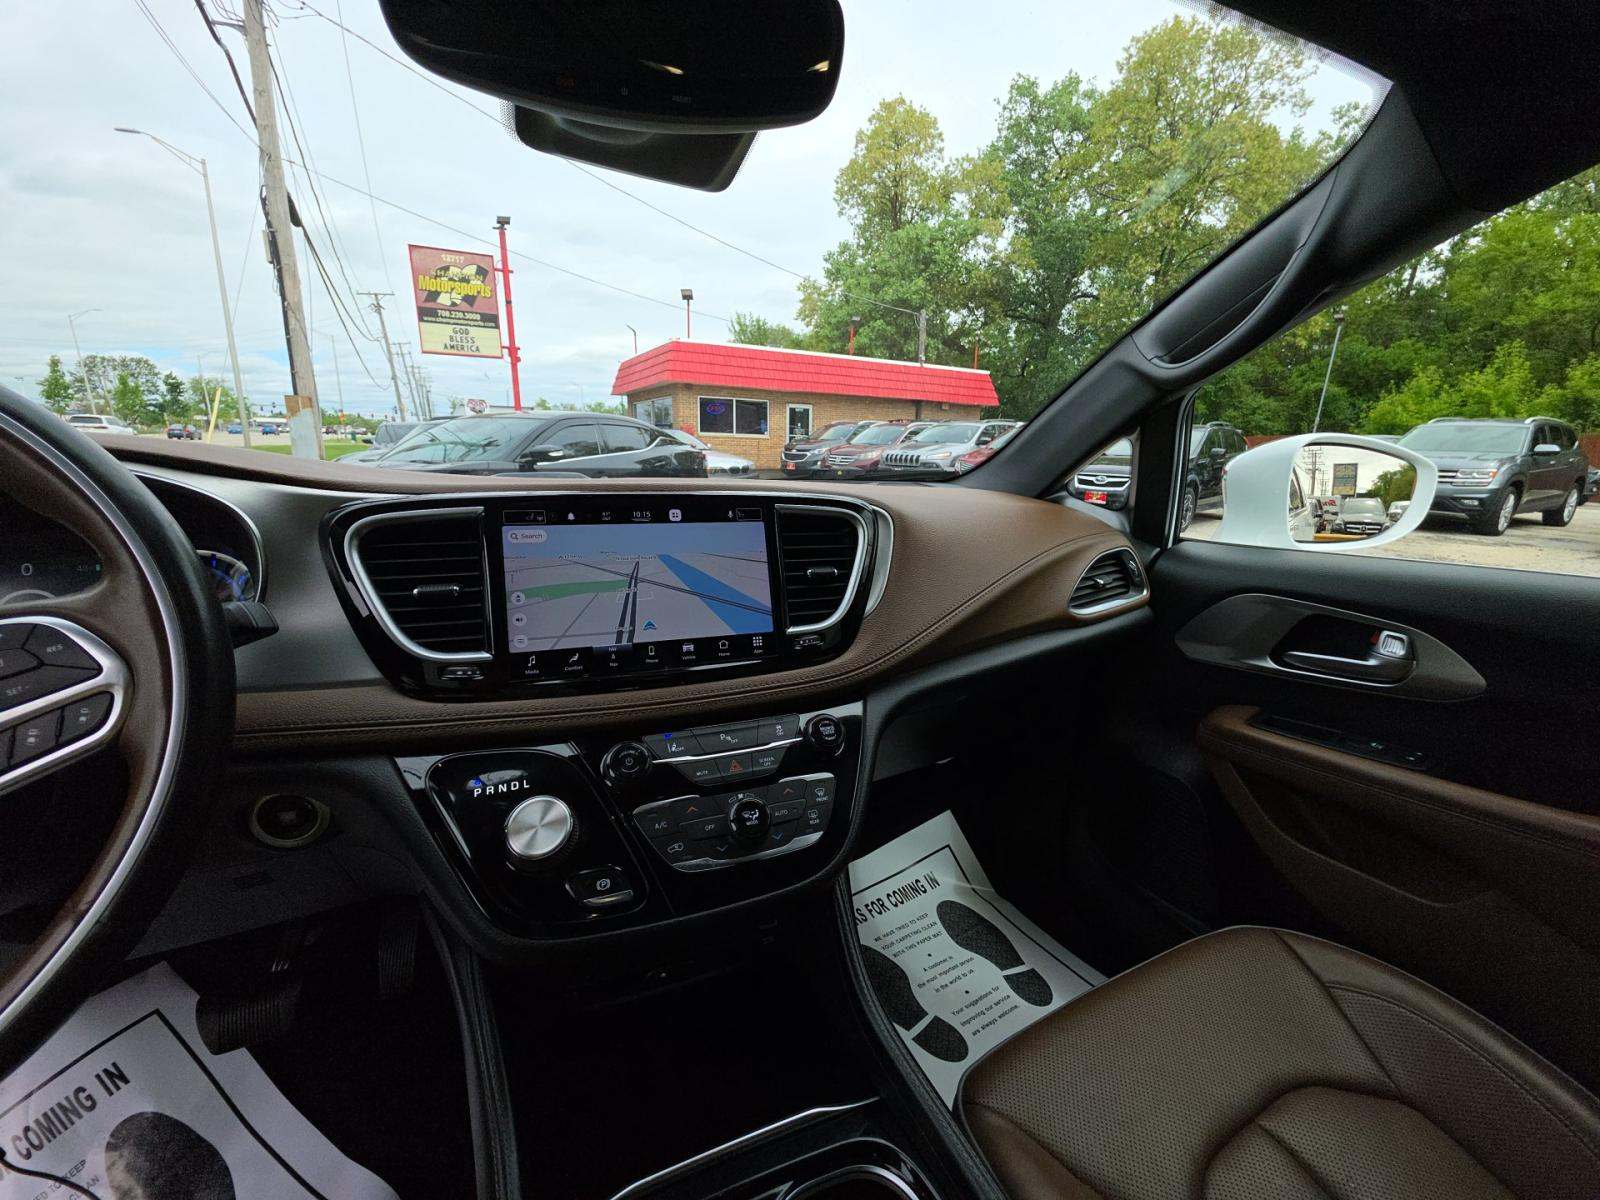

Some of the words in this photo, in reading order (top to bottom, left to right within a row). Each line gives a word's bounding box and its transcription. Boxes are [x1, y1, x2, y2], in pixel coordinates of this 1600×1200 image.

[418, 274, 492, 298] Motorsports
[449, 335, 476, 344] BLESS
[452, 327, 470, 335] GOD
[443, 342, 480, 353] AMERICA
[520, 532, 543, 540] Search
[775, 809, 789, 817] AUTO
[655, 820, 668, 830] A/C
[864, 897, 891, 919] FOR
[886, 878, 928, 908] COMING
[923, 871, 941, 890] IN
[881, 941, 895, 950] YOUR
[895, 928, 922, 944] CARPETING
[921, 920, 938, 932] CLEAN
[882, 930, 896, 938] HAVE
[895, 922, 910, 931] TRIED
[916, 912, 929, 922] KEEP
[892, 949, 906, 958] WITH
[905, 943, 918, 951] THIS
[916, 935, 932, 946] PAPER
[926, 974, 938, 983] most
[937, 963, 960, 976] important
[958, 956, 975, 967] person
[928, 957, 948, 970] customer
[939, 983, 949, 991] the
[949, 974, 963, 985] world
[951, 1007, 964, 1016] Your
[964, 990, 993, 1009] suggestions
[960, 1009, 986, 1027] improving
[984, 1004, 994, 1012] our
[993, 993, 1011, 1007] service
[971, 1028, 981, 1037] are
[980, 1017, 998, 1031] always
[10, 1085, 98, 1161] COMING
[94, 1061, 131, 1098] IN
[69, 1174, 100, 1200] CLAN
